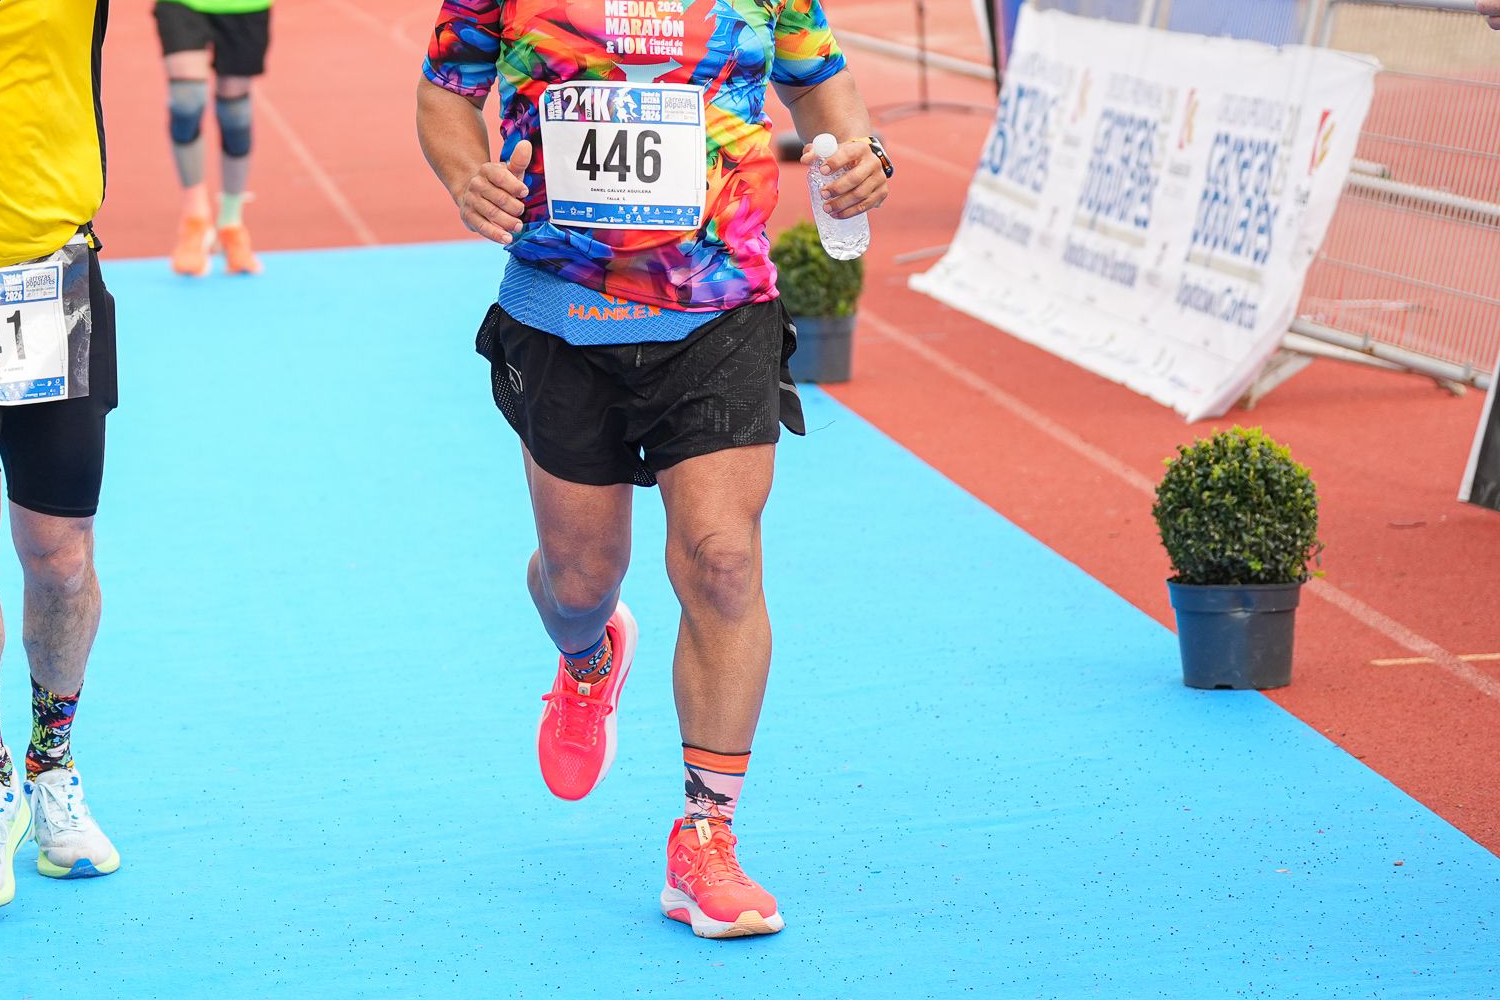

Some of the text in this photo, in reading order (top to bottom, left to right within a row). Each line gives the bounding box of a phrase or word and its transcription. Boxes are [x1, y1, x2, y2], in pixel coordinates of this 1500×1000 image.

[604, 0, 684, 18] MEDIA 2026
[605, 15, 685, 37] MARATÓN
[606, 36, 684, 54] & 10K Ciudad de
[649, 46, 684, 56] LUCENA
[563, 87, 611, 121] 21K
[641, 110, 661, 121] 2026
[576, 128, 662, 184] 446
[568, 303, 662, 321] HANKER
